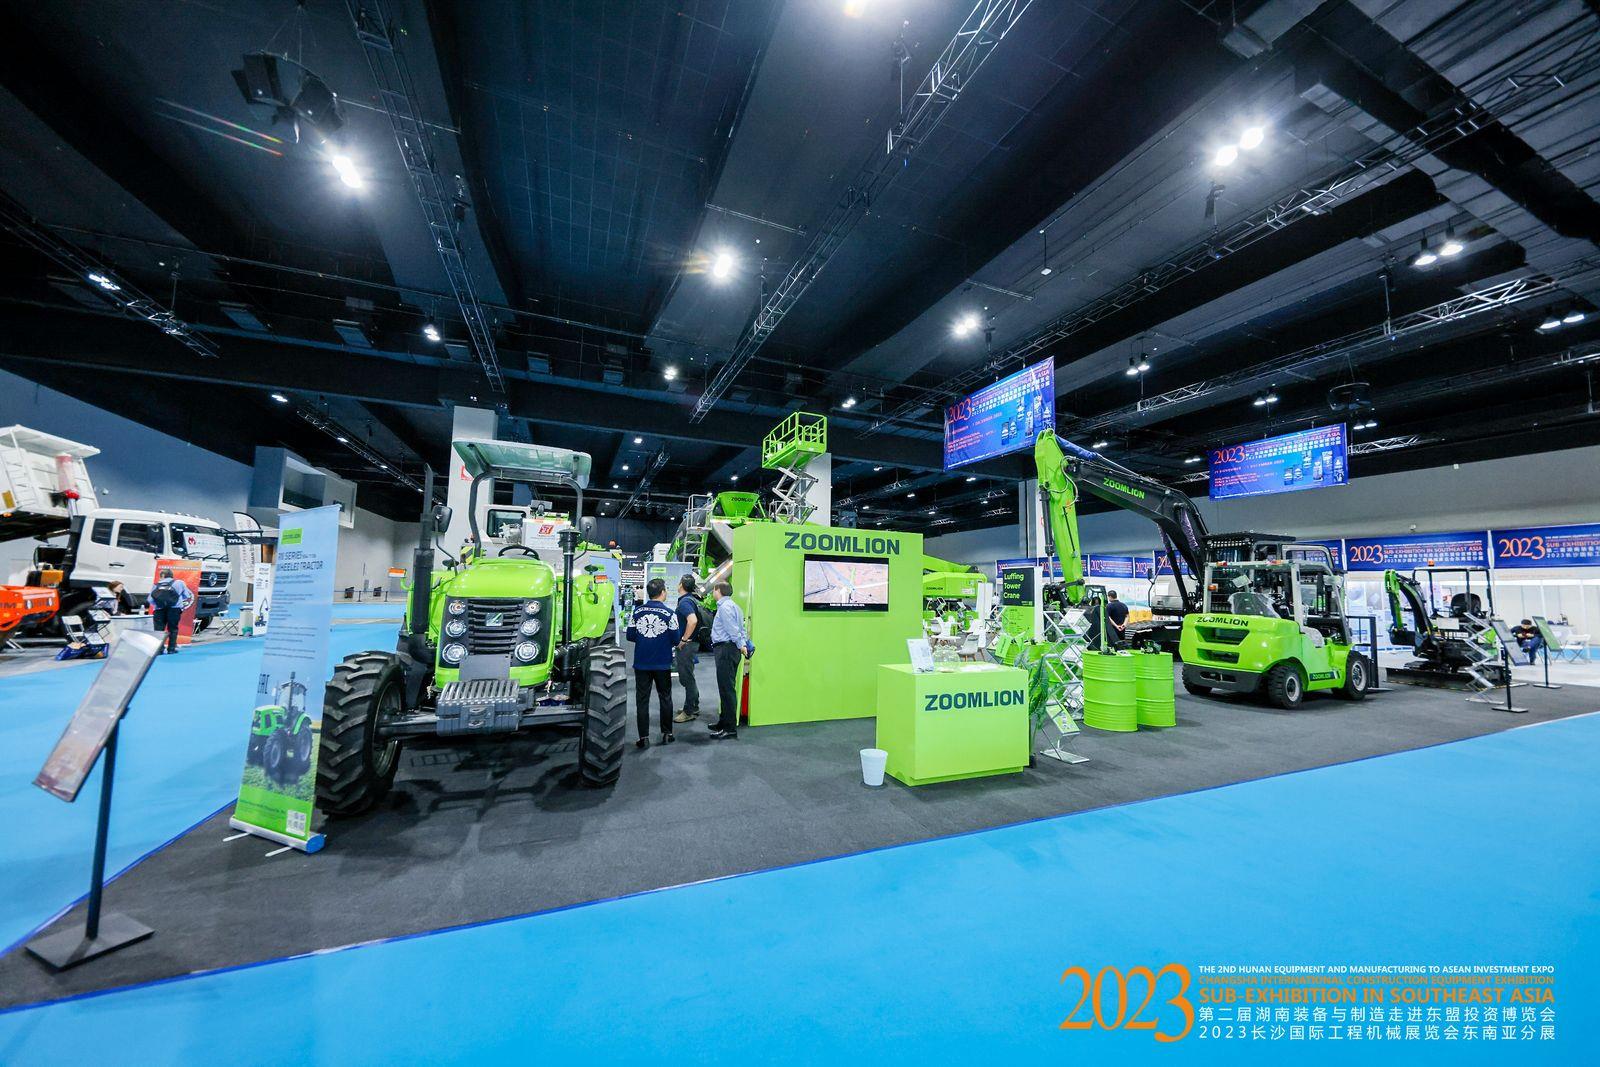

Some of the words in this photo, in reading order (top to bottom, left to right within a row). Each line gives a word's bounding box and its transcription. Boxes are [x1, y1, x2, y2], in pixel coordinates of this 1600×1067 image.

[947, 397, 972, 423] 2023
[1213, 445, 1245, 465] 2023
[1103, 477, 1145, 499] ZOOMLION
[784, 532, 900, 555] ZOOMLION
[1499, 536, 1546, 560] 2023
[1350, 544, 1384, 564] 2023
[1003, 573, 1025, 581] Luffing
[1003, 591, 1020, 599] Crane
[1196, 616, 1249, 627] ZOOMLION
[925, 690, 1025, 711] ZOOMLION
